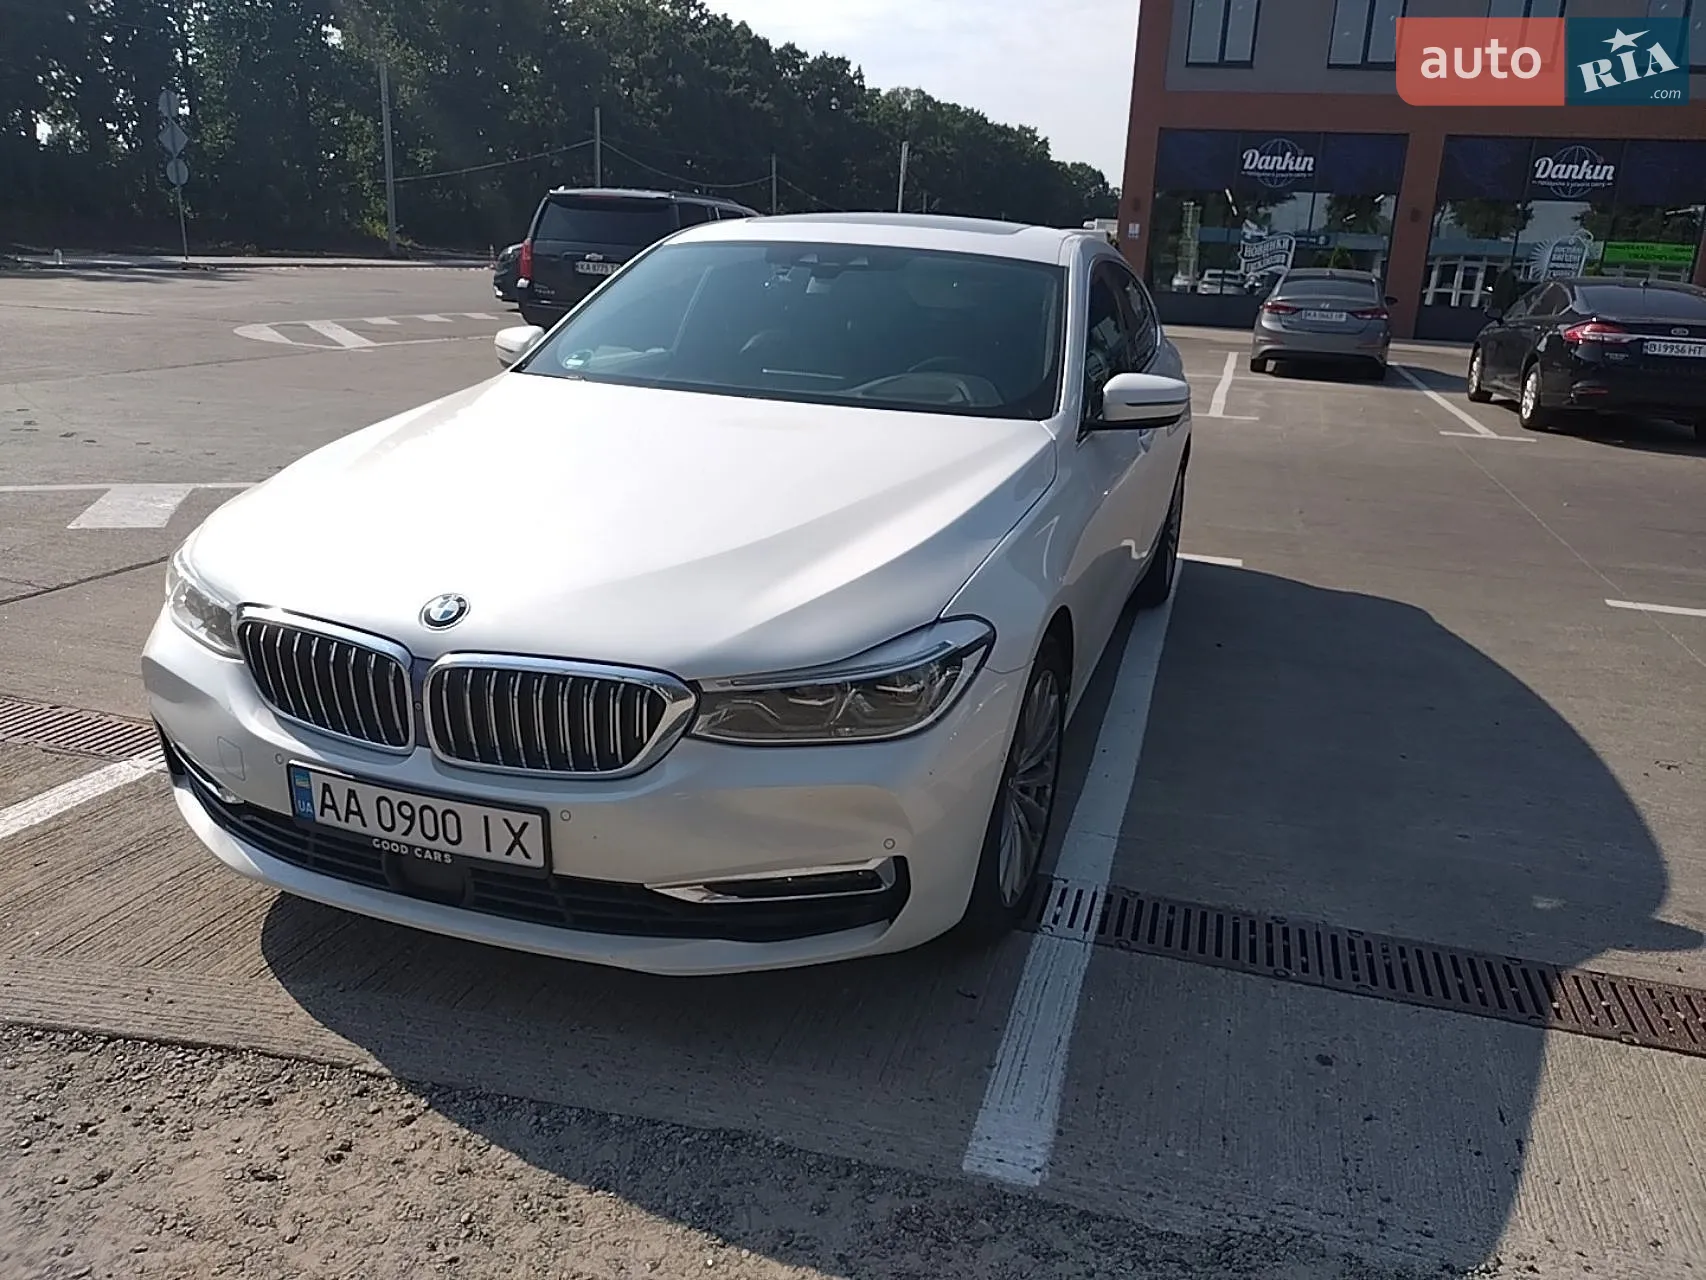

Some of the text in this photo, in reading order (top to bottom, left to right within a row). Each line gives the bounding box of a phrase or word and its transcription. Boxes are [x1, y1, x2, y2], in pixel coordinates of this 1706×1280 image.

[1242, 148, 1314, 171] Dankin
[1534, 156, 1615, 180] Dankin
[297, 799, 314, 814] UA
[319, 782, 532, 860] AA 0900 IX
[372, 838, 453, 864] GOOD CARS
